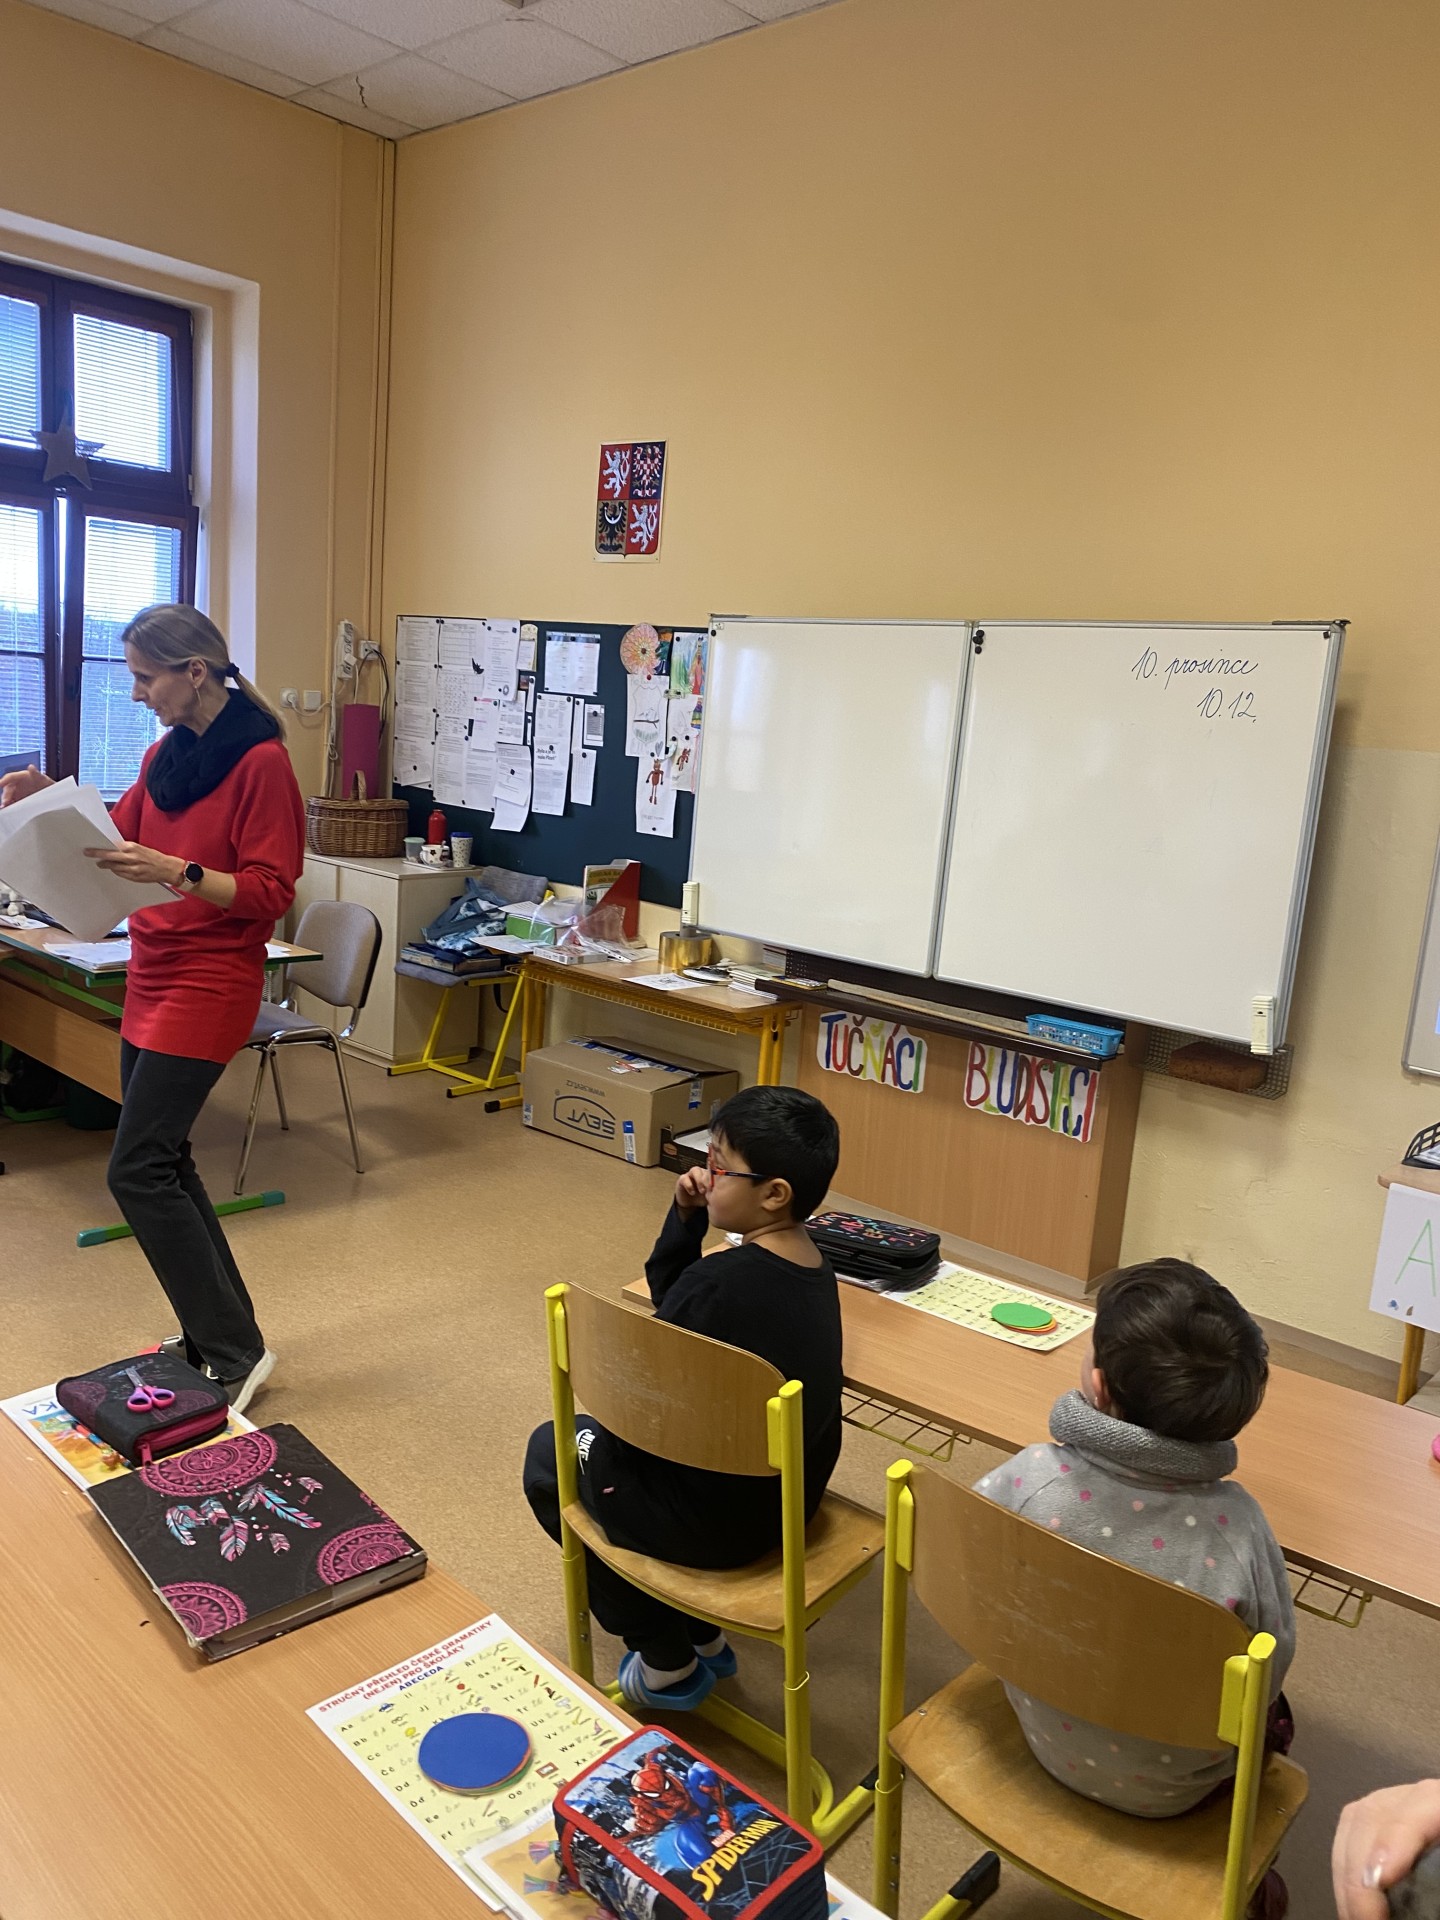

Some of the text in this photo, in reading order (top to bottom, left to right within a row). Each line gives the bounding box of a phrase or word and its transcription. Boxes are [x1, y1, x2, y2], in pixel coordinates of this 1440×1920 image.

[1131, 646, 1259, 690] 10. prosince
[821, 1013, 923, 1092] TUČŇÁCI
[567, 1109, 616, 1135] SEVT
[1395, 1219, 1436, 1297] A
[579, 1432, 596, 1461] NIKE
[319, 1620, 493, 1713] STRUČNÝ PŘEHLED ČESKÉ GRAMATIKY
[363, 1644, 465, 1700] (NEJEN) PRO ŠKOLÁKY
[399, 1665, 444, 1691] ABECEDA
[692, 1818, 783, 1902] SPIDER-MAN
